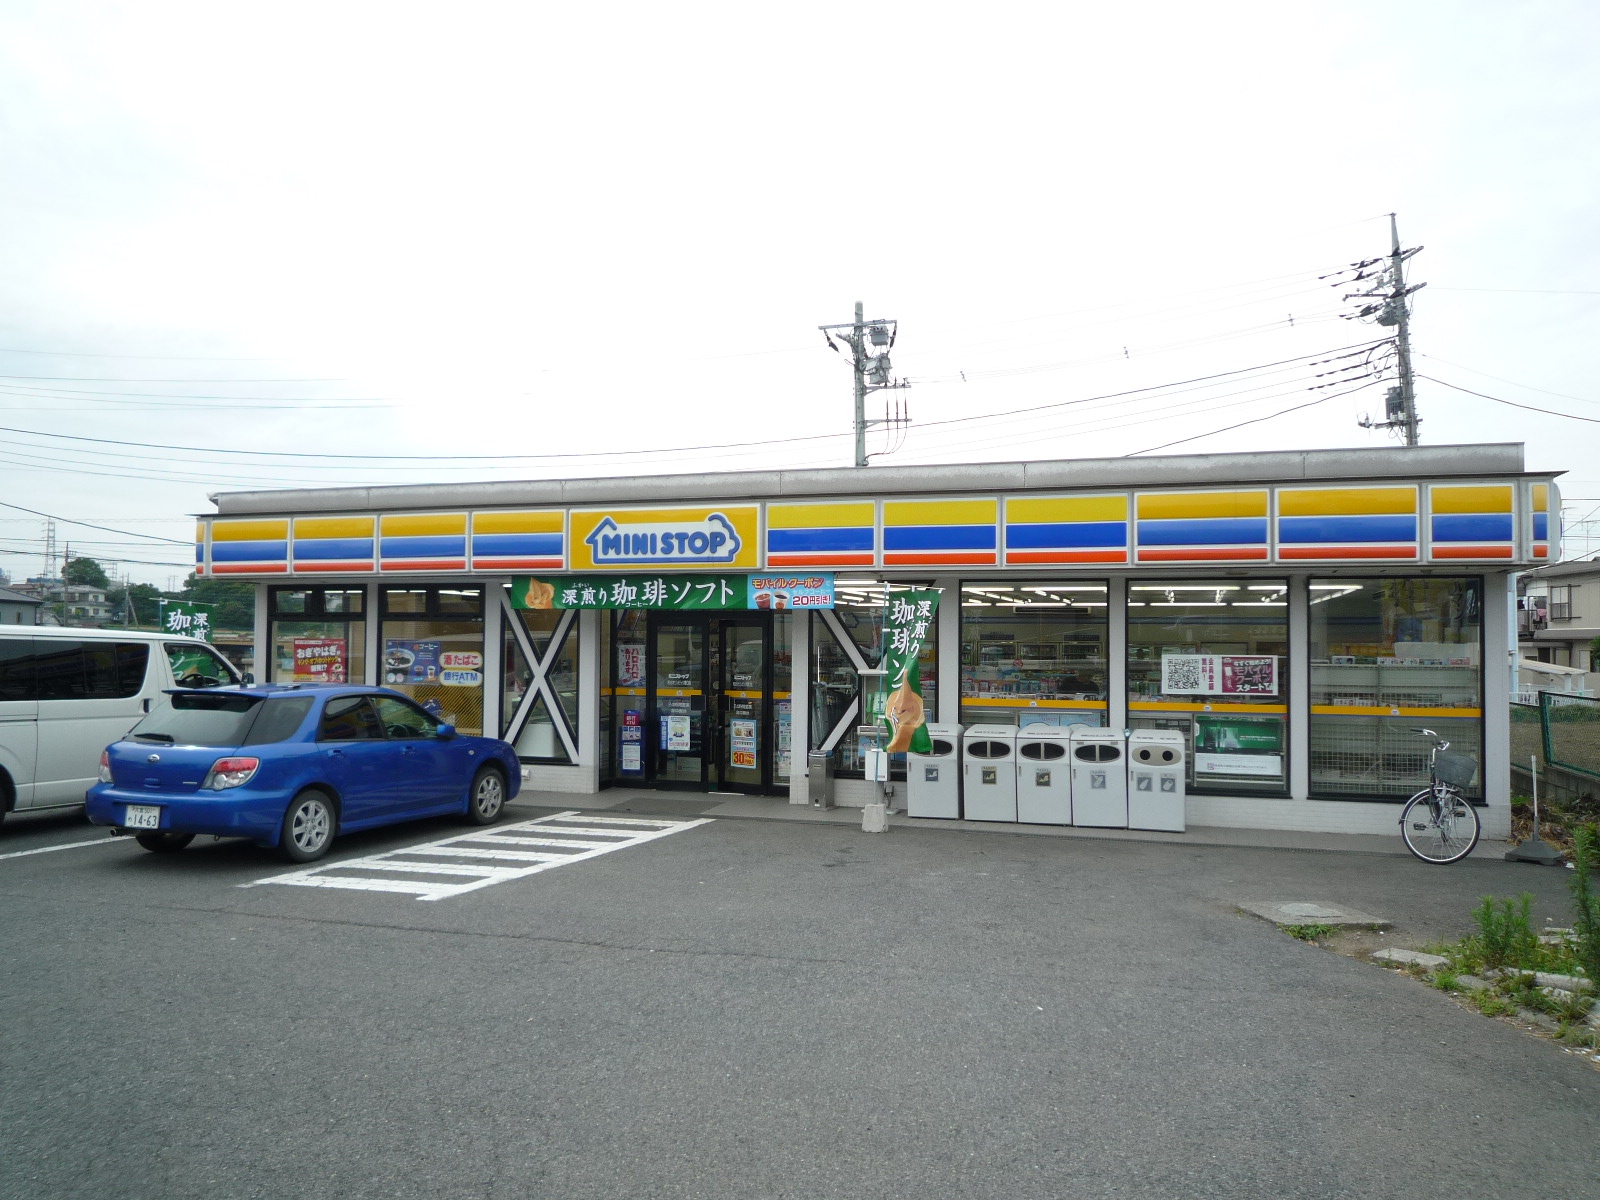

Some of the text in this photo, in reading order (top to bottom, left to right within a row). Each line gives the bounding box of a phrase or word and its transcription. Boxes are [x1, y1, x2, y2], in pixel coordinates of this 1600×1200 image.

[602, 531, 727, 555] MINISTOP
[911, 600, 932, 659] 深煎り
[1234, 665, 1272, 675] モバイル
